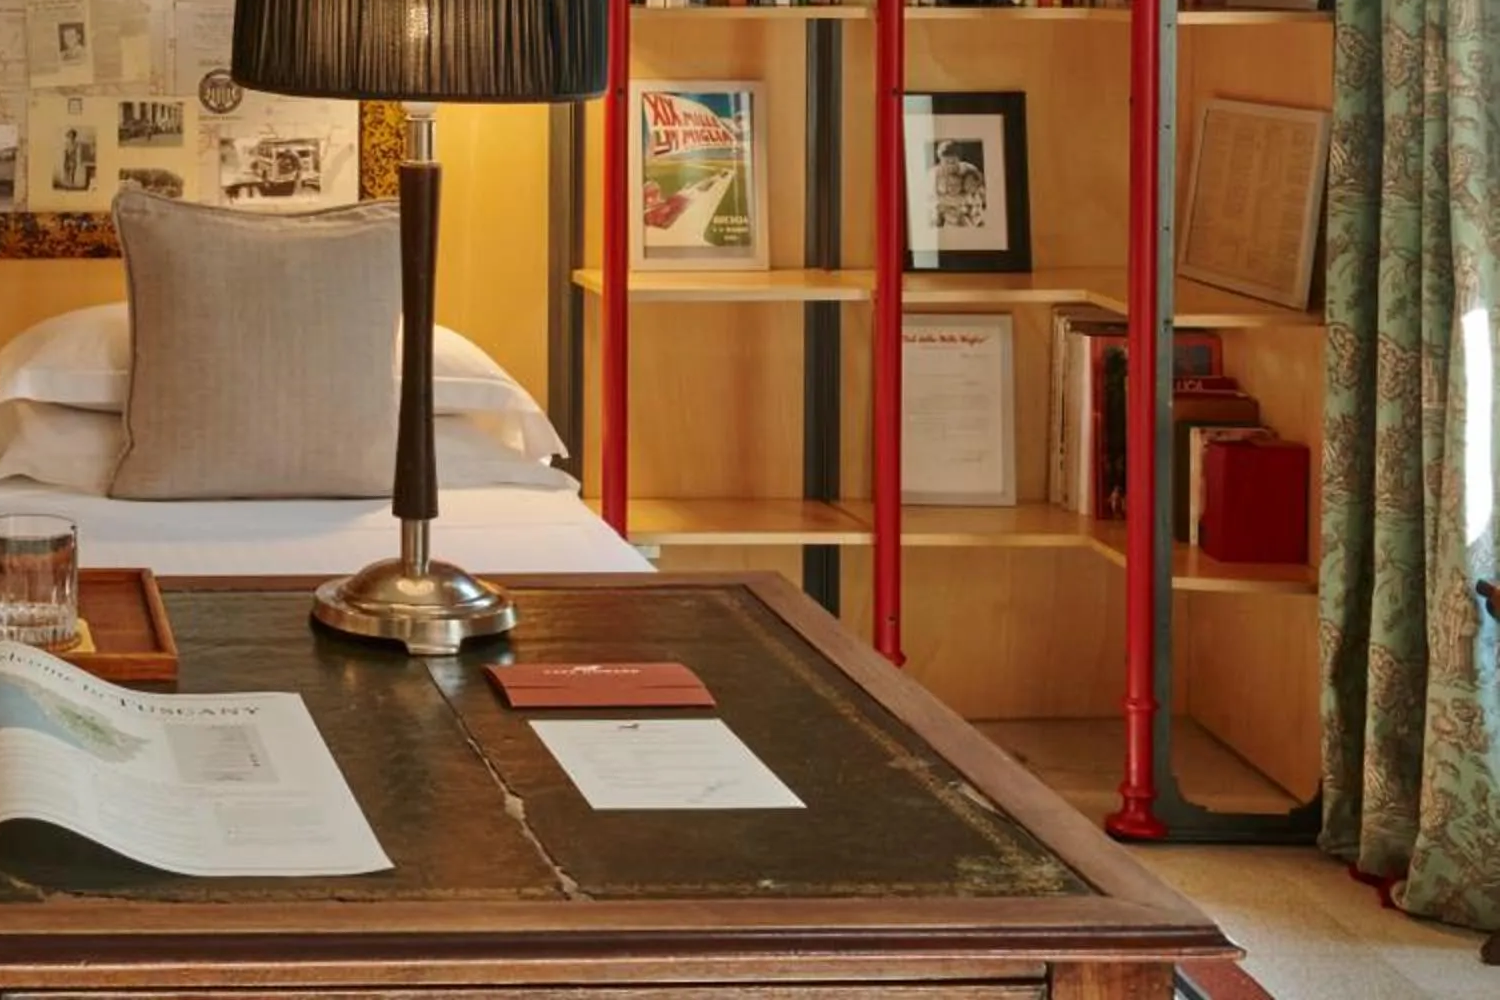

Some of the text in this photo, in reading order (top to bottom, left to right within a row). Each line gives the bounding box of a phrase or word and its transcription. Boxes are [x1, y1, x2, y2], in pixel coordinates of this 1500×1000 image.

[643, 92, 683, 127] XIX
[682, 128, 735, 146] MIGLIA
[116, 697, 261, 717] TUSCANY
